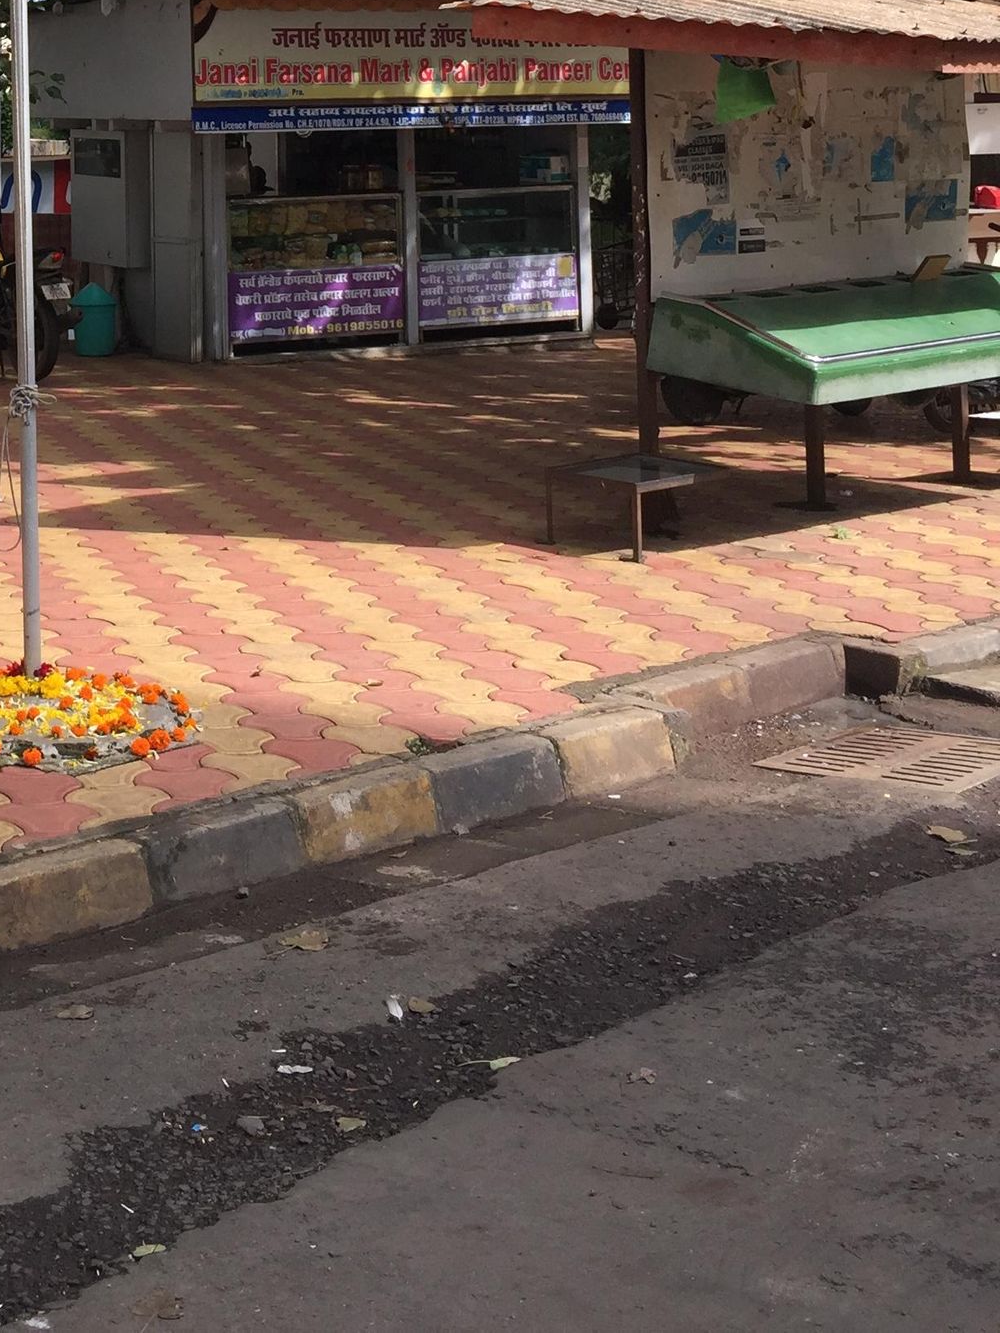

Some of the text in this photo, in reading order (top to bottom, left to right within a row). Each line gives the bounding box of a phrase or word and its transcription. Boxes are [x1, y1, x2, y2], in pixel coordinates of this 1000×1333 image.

[271, 22, 321, 50] जनाई
[323, 27, 390, 49] फरसाण
[393, 23, 426, 49] मार्ट
[196, 57, 258, 86] Janai
[264, 57, 354, 85] Farsana
[359, 57, 412, 84] Mart
[418, 57, 435, 83] &
[441, 57, 517, 89] Panjabi
[524, 57, 593, 83] Paneer
